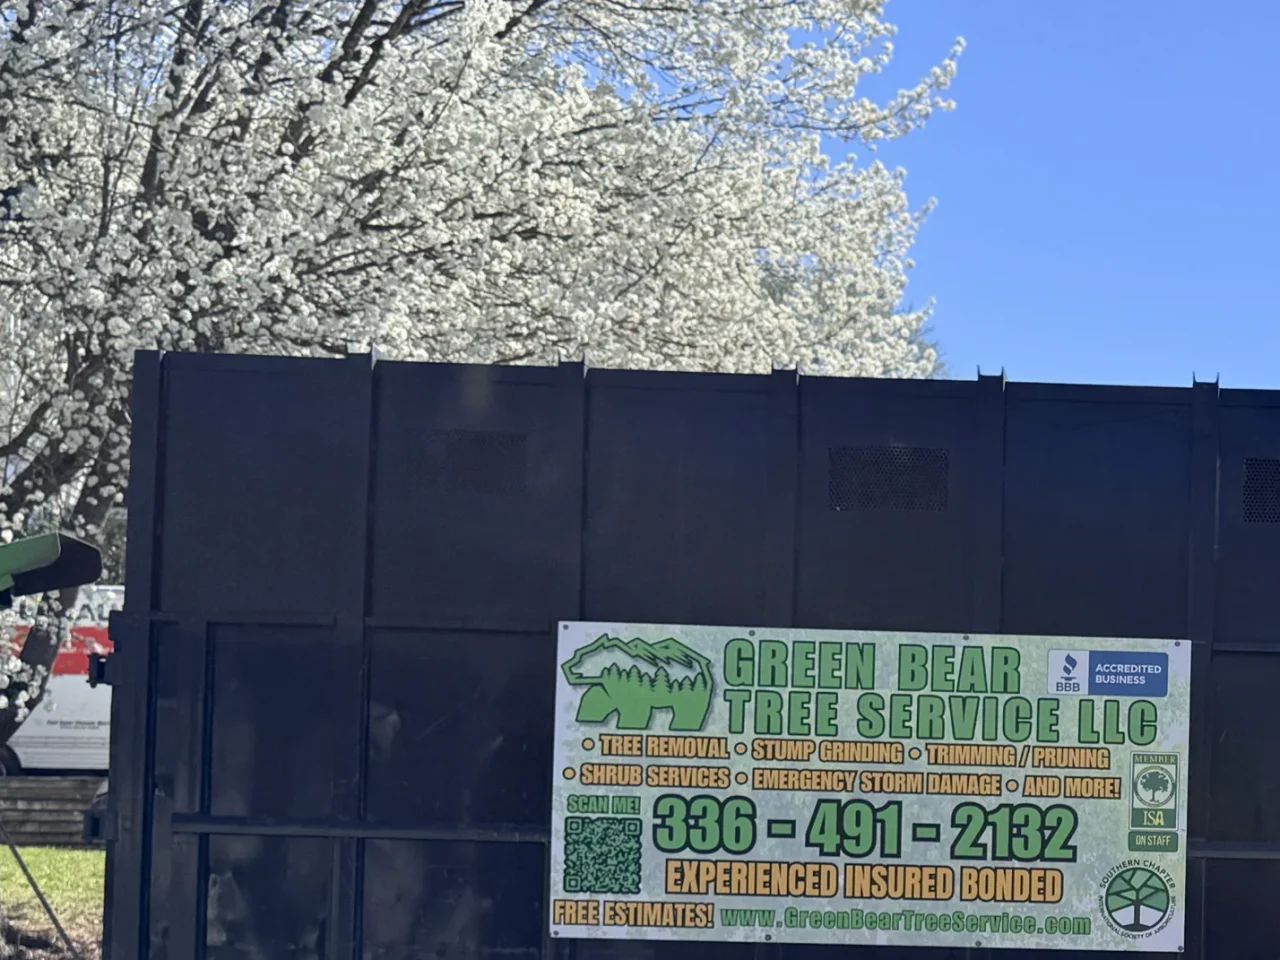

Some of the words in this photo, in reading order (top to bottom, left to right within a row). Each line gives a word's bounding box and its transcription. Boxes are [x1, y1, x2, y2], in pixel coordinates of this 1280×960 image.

[723, 638, 876, 690] GREEN
[898, 643, 1021, 694] BEAR
[1095, 664, 1162, 674] ACCREDITED
[1095, 674, 1146, 685] BUSINESS
[1056, 681, 1080, 692] BBB
[723, 689, 838, 737] TREE
[857, 692, 1060, 743] SERVICE
[1078, 699, 1158, 746] LLC
[599, 733, 643, 757] TREE
[646, 735, 730, 759] REMOVAL
[751, 738, 816, 761] STUMP
[818, 740, 904, 765] GRINDING
[925, 743, 1017, 768] TRIMMING
[1032, 746, 1110, 770] PRUNING
[1134, 755, 1176, 763] MEMBER
[580, 762, 643, 786] SHRUB
[646, 765, 730, 789] SERVICES
[752, 767, 859, 792] EMERGENCY
[860, 771, 924, 794] STORM
[926, 772, 1002, 797] DAMAGE
[1023, 776, 1061, 798] AND
[1064, 777, 1121, 800] MORE!
[567, 795, 609, 814] SCAN
[611, 796, 641, 815] ME!
[1143, 811, 1165, 826] ISA
[1135, 835, 1146, 845] ON
[1148, 835, 1171, 846] STAFF
[665, 858, 838, 897] EXPERIENCED
[844, 863, 954, 901] INSURED
[960, 866, 1064, 903] BONDED
[1100, 859, 1140, 889] SOUTHERN
[1143, 860, 1176, 889] CHAPTER
[553, 899, 600, 925] FREE
[603, 901, 714, 928] ESTIMATES!
[720, 907, 1092, 935] www.GreenBearTreeService.com
